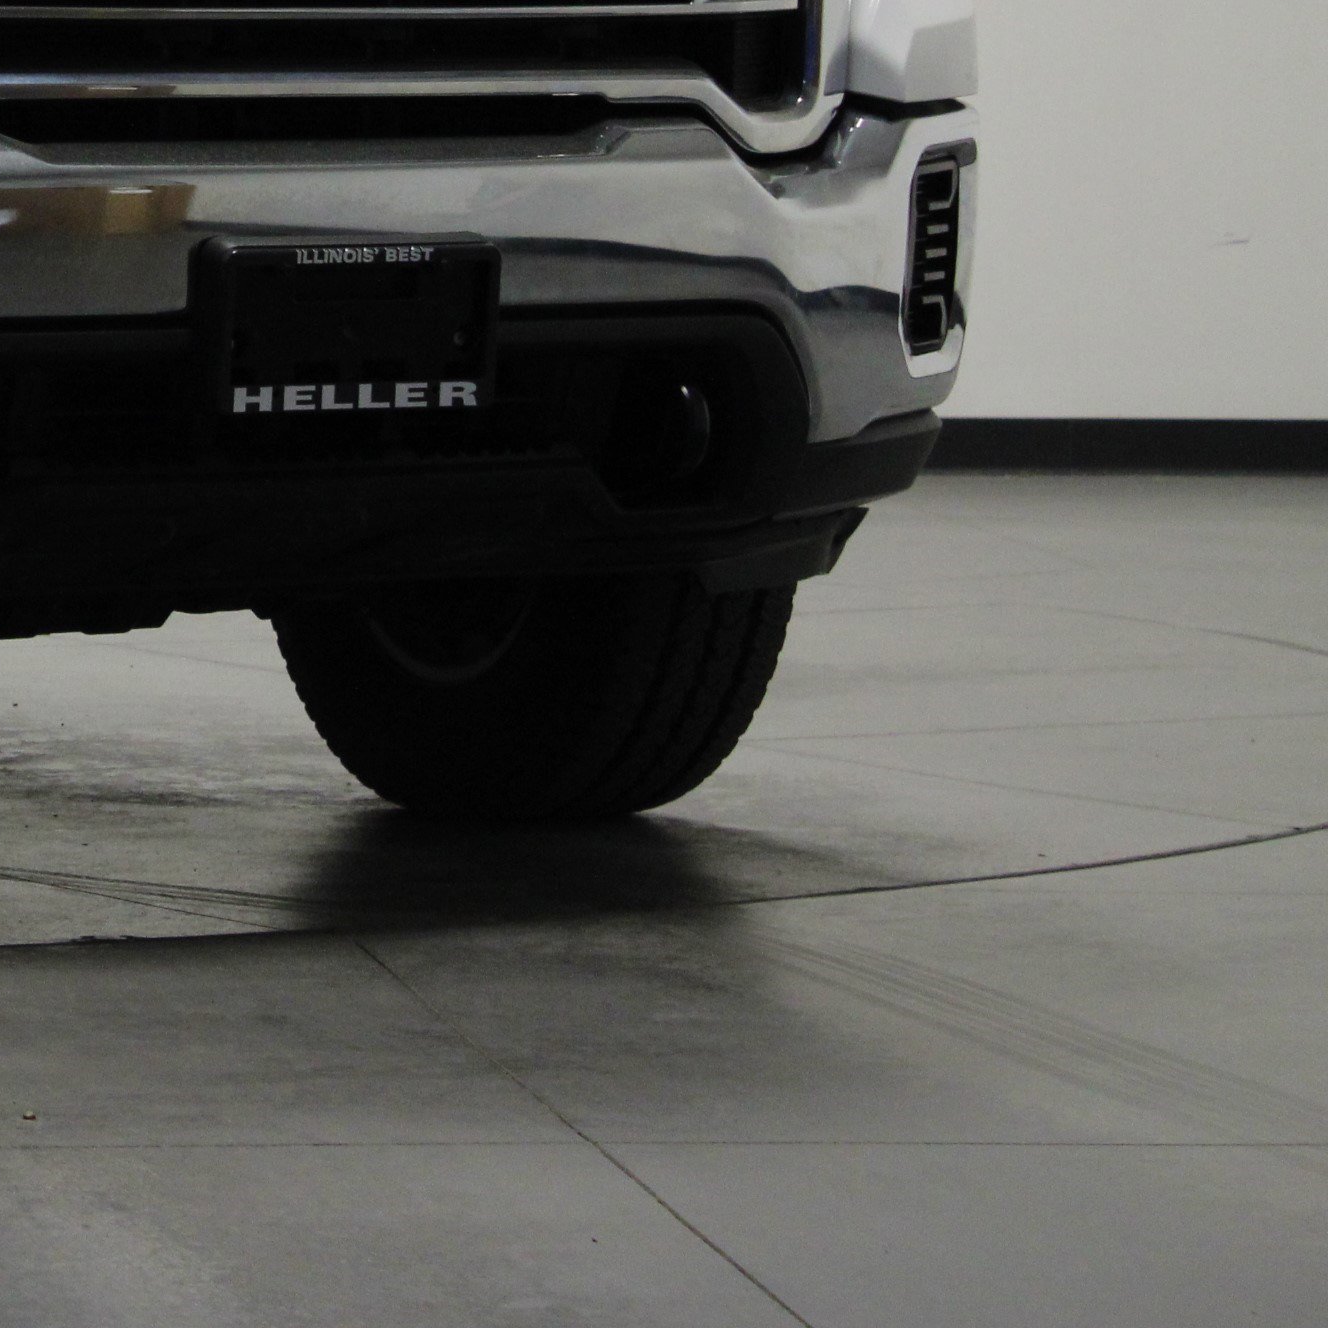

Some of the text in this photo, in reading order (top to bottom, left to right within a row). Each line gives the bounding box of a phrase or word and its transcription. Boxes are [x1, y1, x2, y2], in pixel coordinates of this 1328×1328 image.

[295, 245, 435, 265] ILLINOIS' BEST
[232, 380, 478, 413] HELLER
